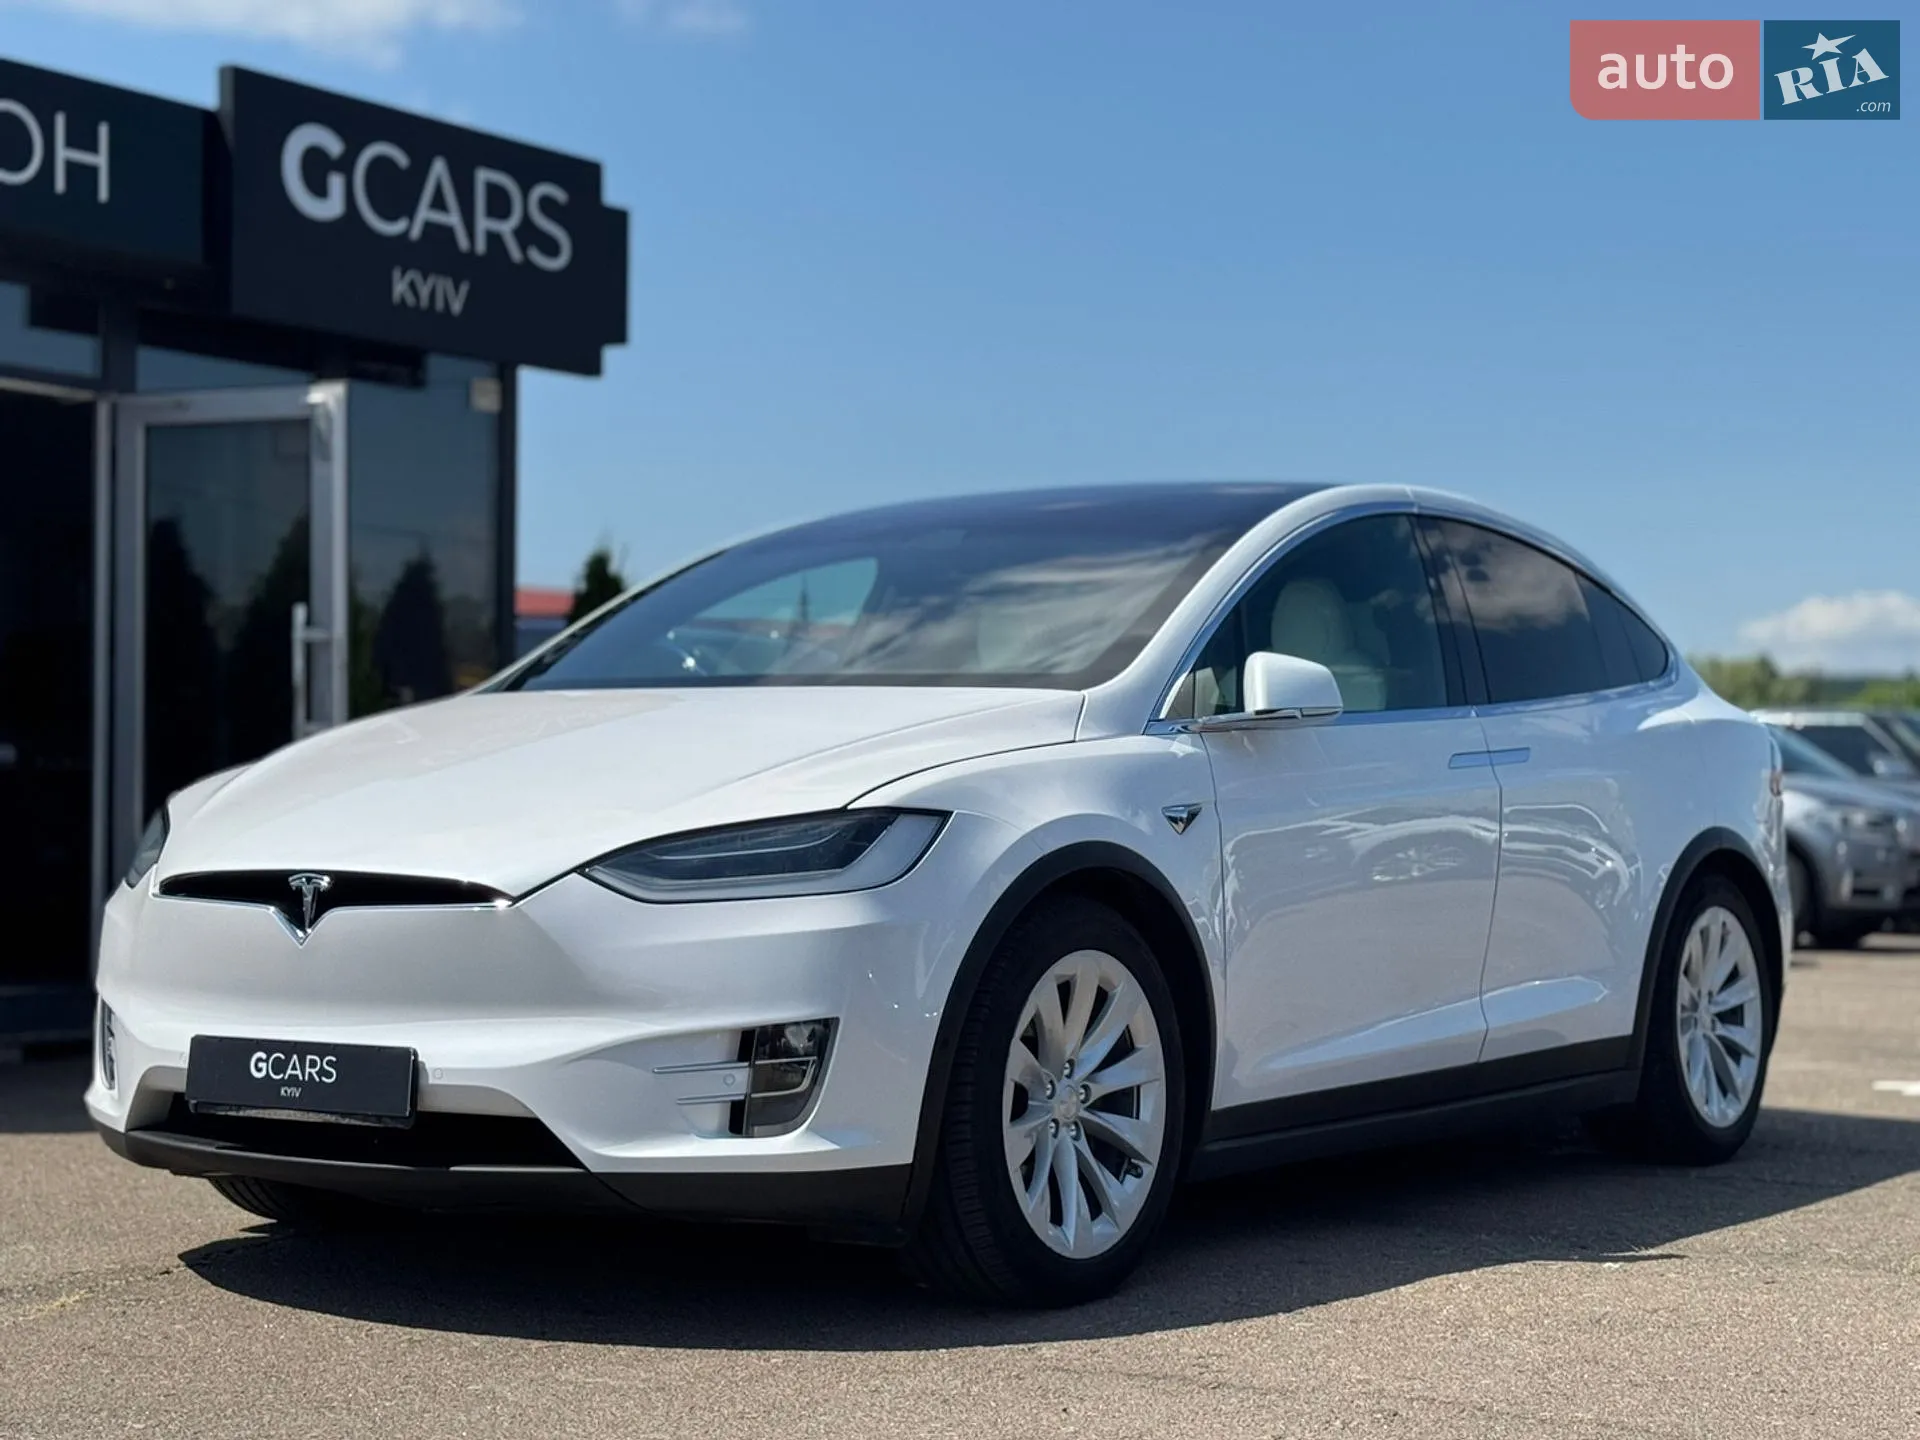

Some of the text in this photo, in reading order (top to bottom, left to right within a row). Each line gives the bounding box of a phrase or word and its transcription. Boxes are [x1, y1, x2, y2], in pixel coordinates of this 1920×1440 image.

[281, 122, 573, 271] GCARS
[391, 266, 470, 317] KYIV
[250, 1051, 337, 1083] GCARS
[280, 1086, 302, 1097] KYIV
